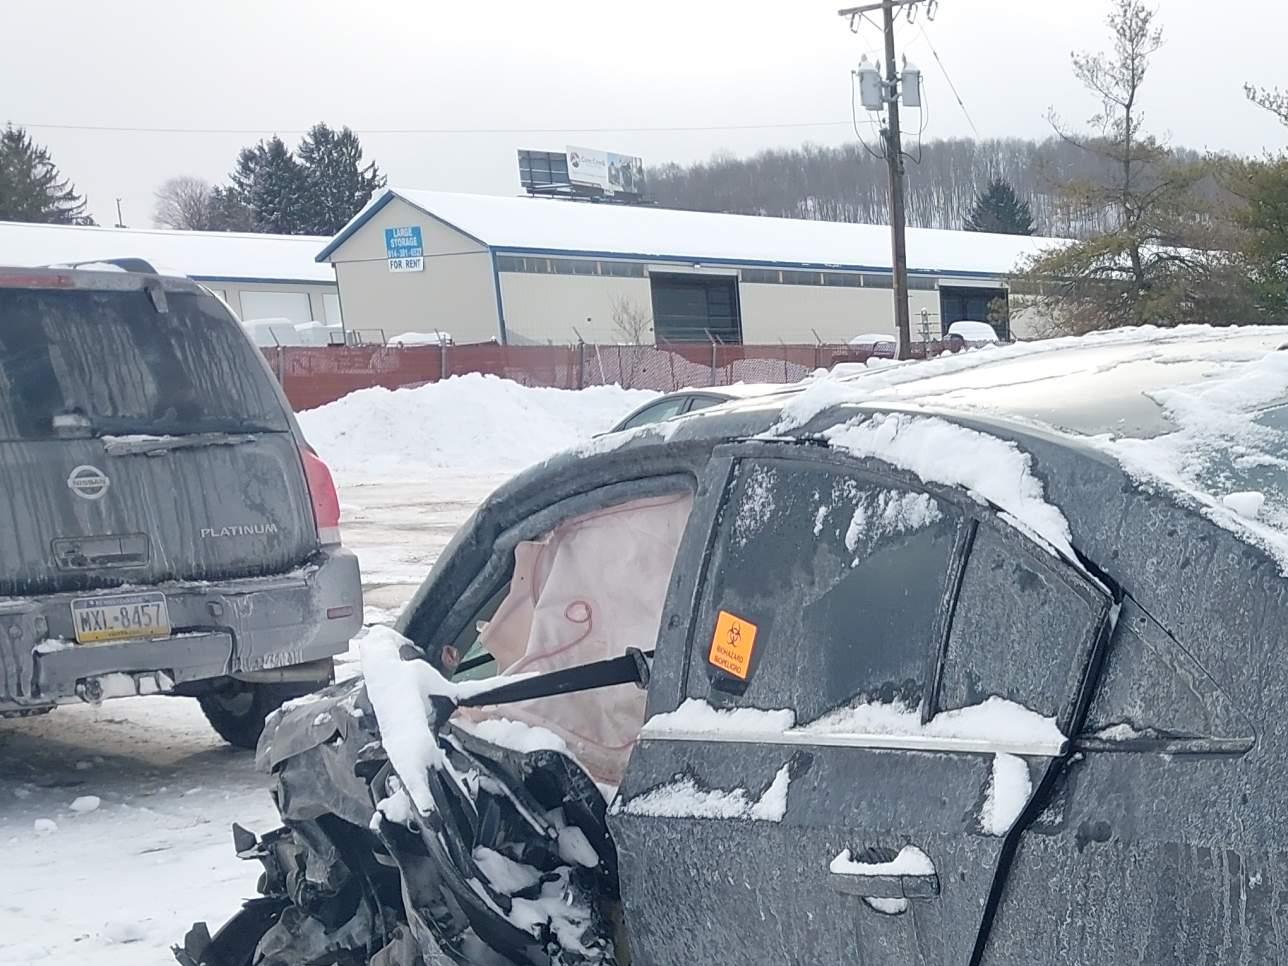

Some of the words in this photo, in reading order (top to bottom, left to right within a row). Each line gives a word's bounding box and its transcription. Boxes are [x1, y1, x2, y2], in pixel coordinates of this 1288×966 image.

[392, 228, 413, 238] LARGE
[390, 236, 418, 248] STORAGE
[389, 259, 403, 270] FOR
[405, 258, 421, 269] RENT
[200, 523, 278, 538] PLATINUM
